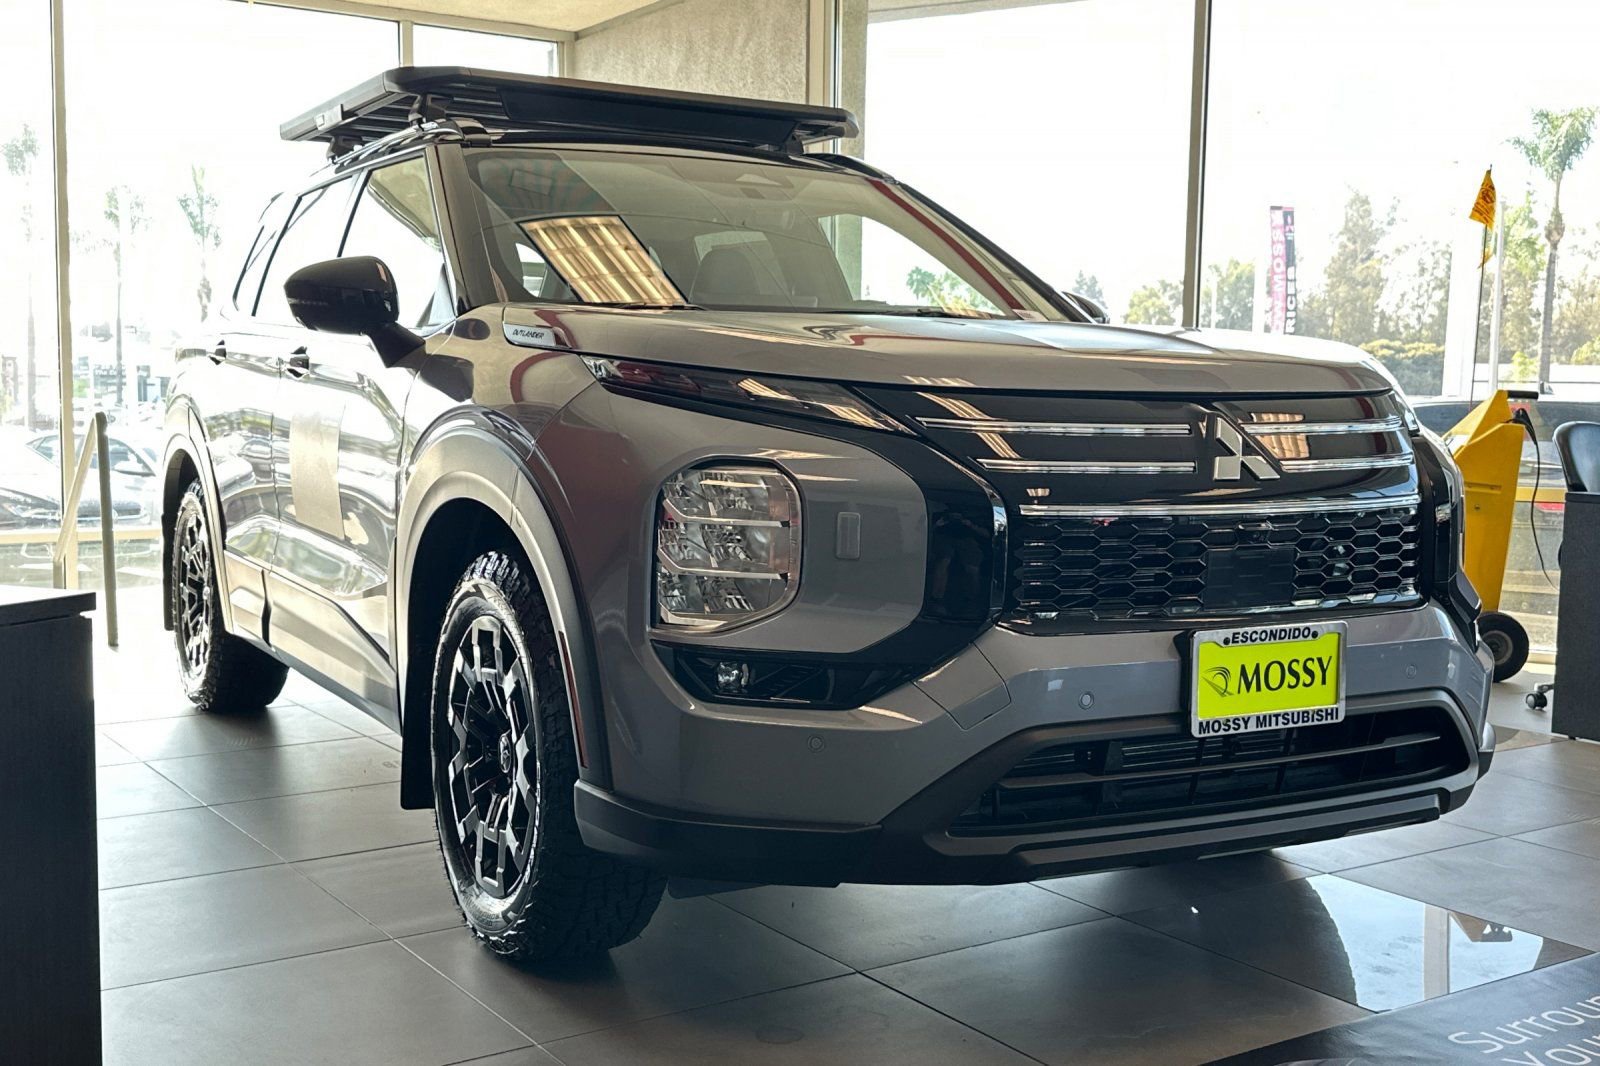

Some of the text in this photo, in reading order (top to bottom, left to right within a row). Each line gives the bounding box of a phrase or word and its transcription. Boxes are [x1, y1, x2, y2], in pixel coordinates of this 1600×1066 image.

[1271, 210, 1284, 292] MOSSY
[1285, 266, 1296, 333] RICES
[512, 328, 545, 339] OUTLANDER
[1231, 626, 1311, 644] ESCONDIDO
[1237, 655, 1333, 695] MOSSY
[1198, 707, 1339, 735] MOSSY MITSUBISHI
[1501, 1035, 1600, 1066] You
